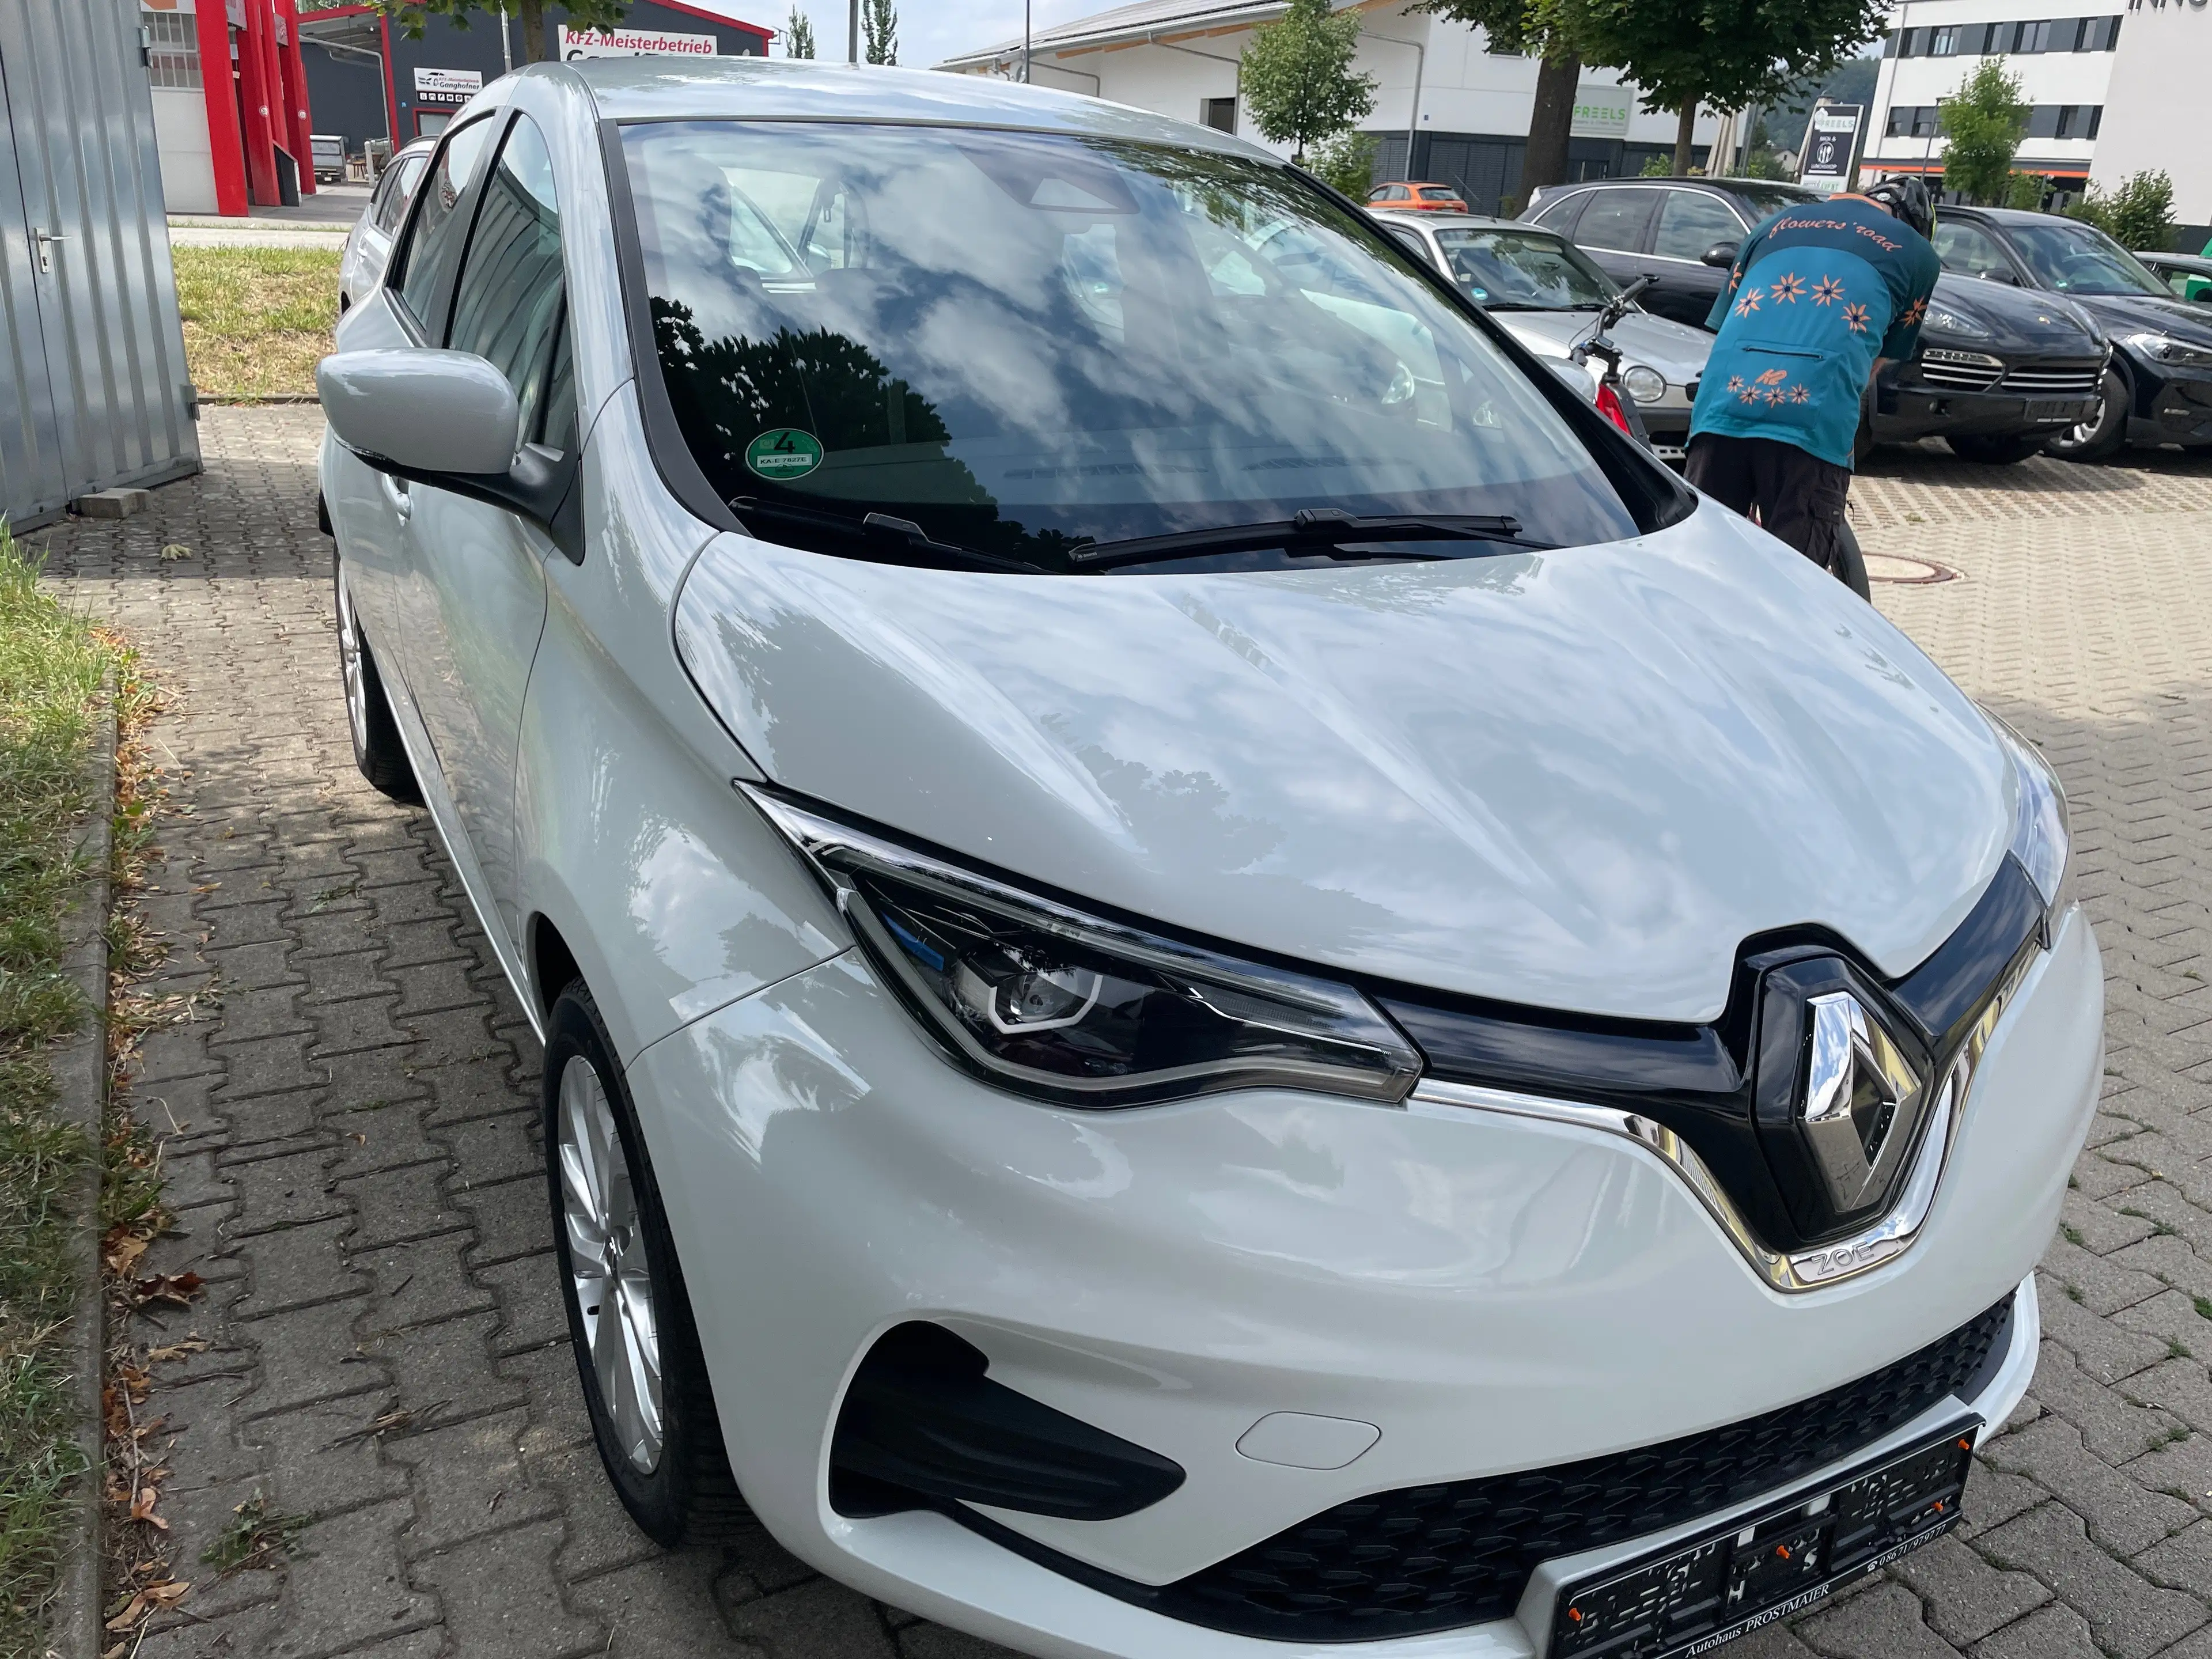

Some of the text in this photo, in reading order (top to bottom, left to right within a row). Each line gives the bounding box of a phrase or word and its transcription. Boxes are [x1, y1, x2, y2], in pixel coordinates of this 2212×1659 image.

[440, 81, 480, 90] Ganghofner
[1574, 106, 1626, 120] FREELS
[1769, 216, 1847, 240] flowers
[774, 431, 796, 454] 4
[1811, 1241, 1874, 1275] ZOE
[1684, 1584, 1830, 1658] Autohaus PROSTMAIER
